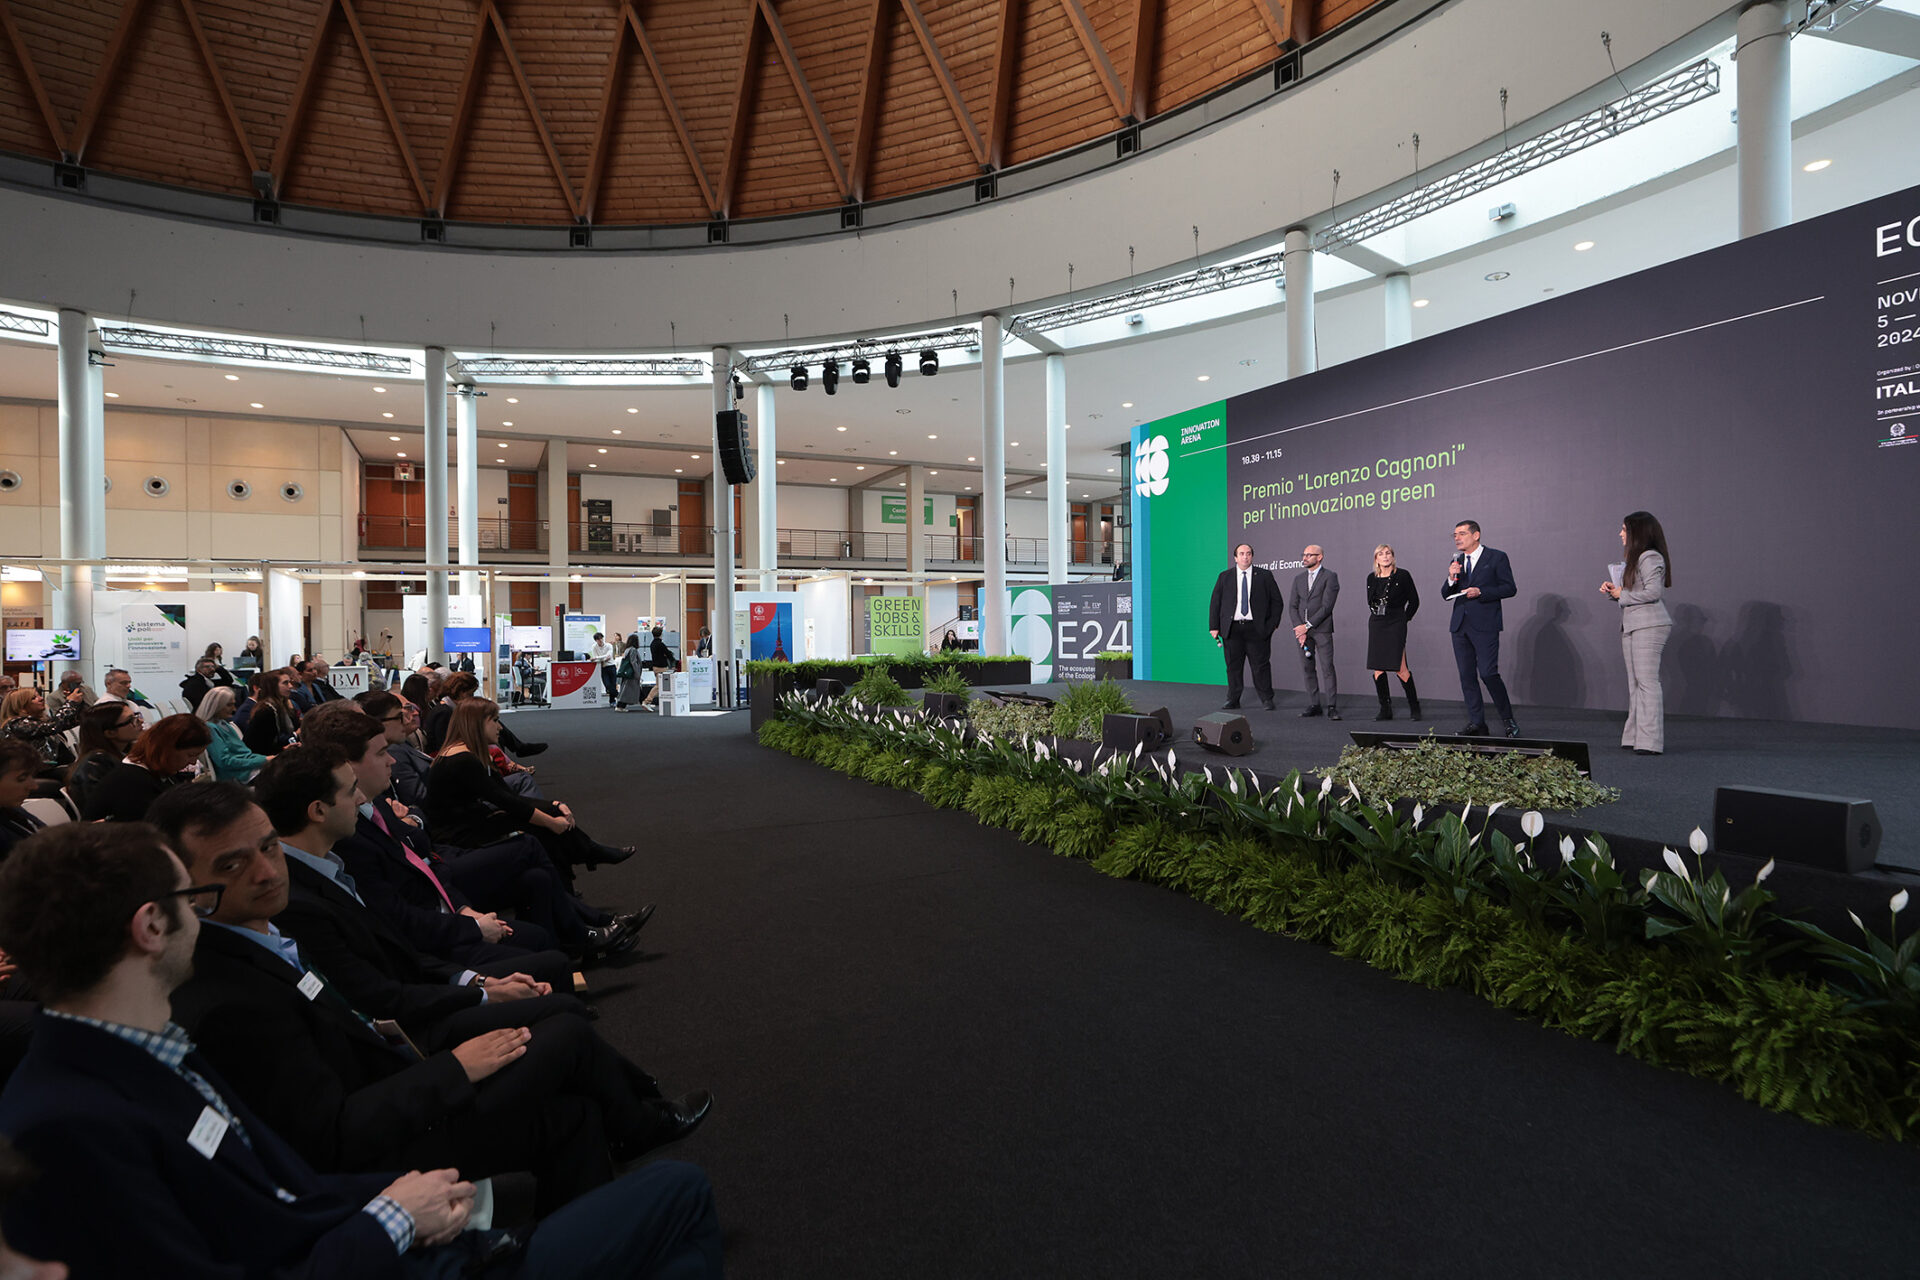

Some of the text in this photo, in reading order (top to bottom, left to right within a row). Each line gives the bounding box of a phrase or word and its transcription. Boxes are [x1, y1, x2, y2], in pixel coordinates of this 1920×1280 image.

[1877, 287, 1920, 310] NOV
[1877, 314, 1889, 329] 5
[1876, 367, 1904, 376] Organized
[1884, 405, 1916, 415] partnership
[1180, 418, 1220, 437] INNOVATION
[1180, 433, 1202, 446] ARENA
[1241, 453, 1260, 465] 10.30
[1266, 448, 1283, 460] 11.15
[1243, 442, 1465, 502] Premio "Lorenzo Cagnoni"
[1243, 482, 1435, 529] per l'innovazione green
[1269, 560, 1278, 571] di
[873, 599, 920, 611] GREEN
[873, 611, 920, 624] JOBS &
[874, 624, 920, 637] SKILLS
[1057, 619, 1132, 660] E24
[1058, 664, 1069, 672] The
